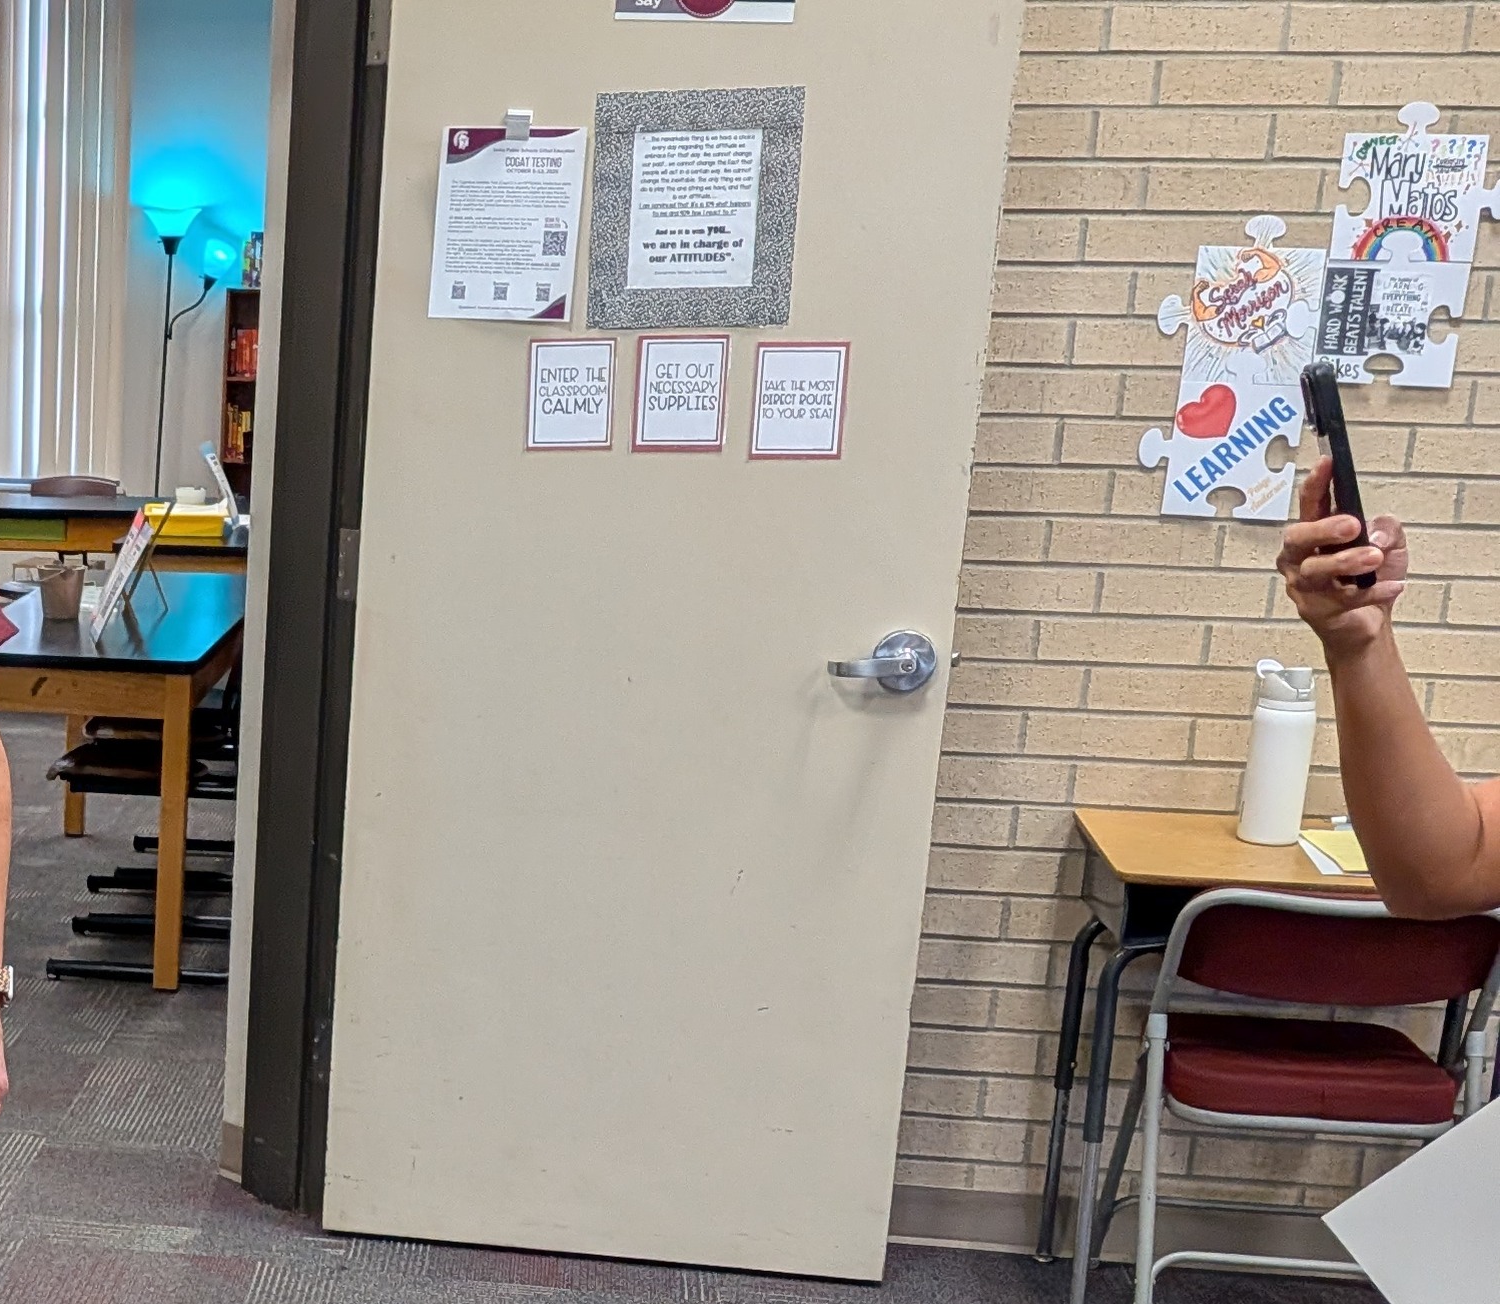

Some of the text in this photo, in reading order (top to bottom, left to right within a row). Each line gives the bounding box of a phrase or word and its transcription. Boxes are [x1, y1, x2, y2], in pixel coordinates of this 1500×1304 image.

[505, 157, 562, 167] COGAT TESTING
[1370, 146, 1426, 183] Mary
[1380, 178, 1458, 222] Matos
[1373, 218, 1439, 242] CREATE
[680, 239, 689, 248] in
[694, 240, 729, 250] charge
[732, 239, 744, 247] of
[1218, 280, 1289, 337] Morrison
[1324, 274, 1348, 350] HARD WORK
[1343, 268, 1368, 354] BEATS TALENT
[541, 367, 607, 383] ENTER THE
[656, 364, 714, 378] GET OUT
[539, 385, 606, 397] CLASSROOM
[650, 381, 717, 394] NECESSARY
[765, 380, 835, 391] TAKE THE MOST
[542, 397, 603, 414] CALMLY
[649, 396, 717, 410] SUPPLIES
[763, 394, 832, 405] DIRECT ROUTE
[763, 408, 832, 419] TO YOUR SEAT
[1173, 397, 1297, 502] LEARNING
